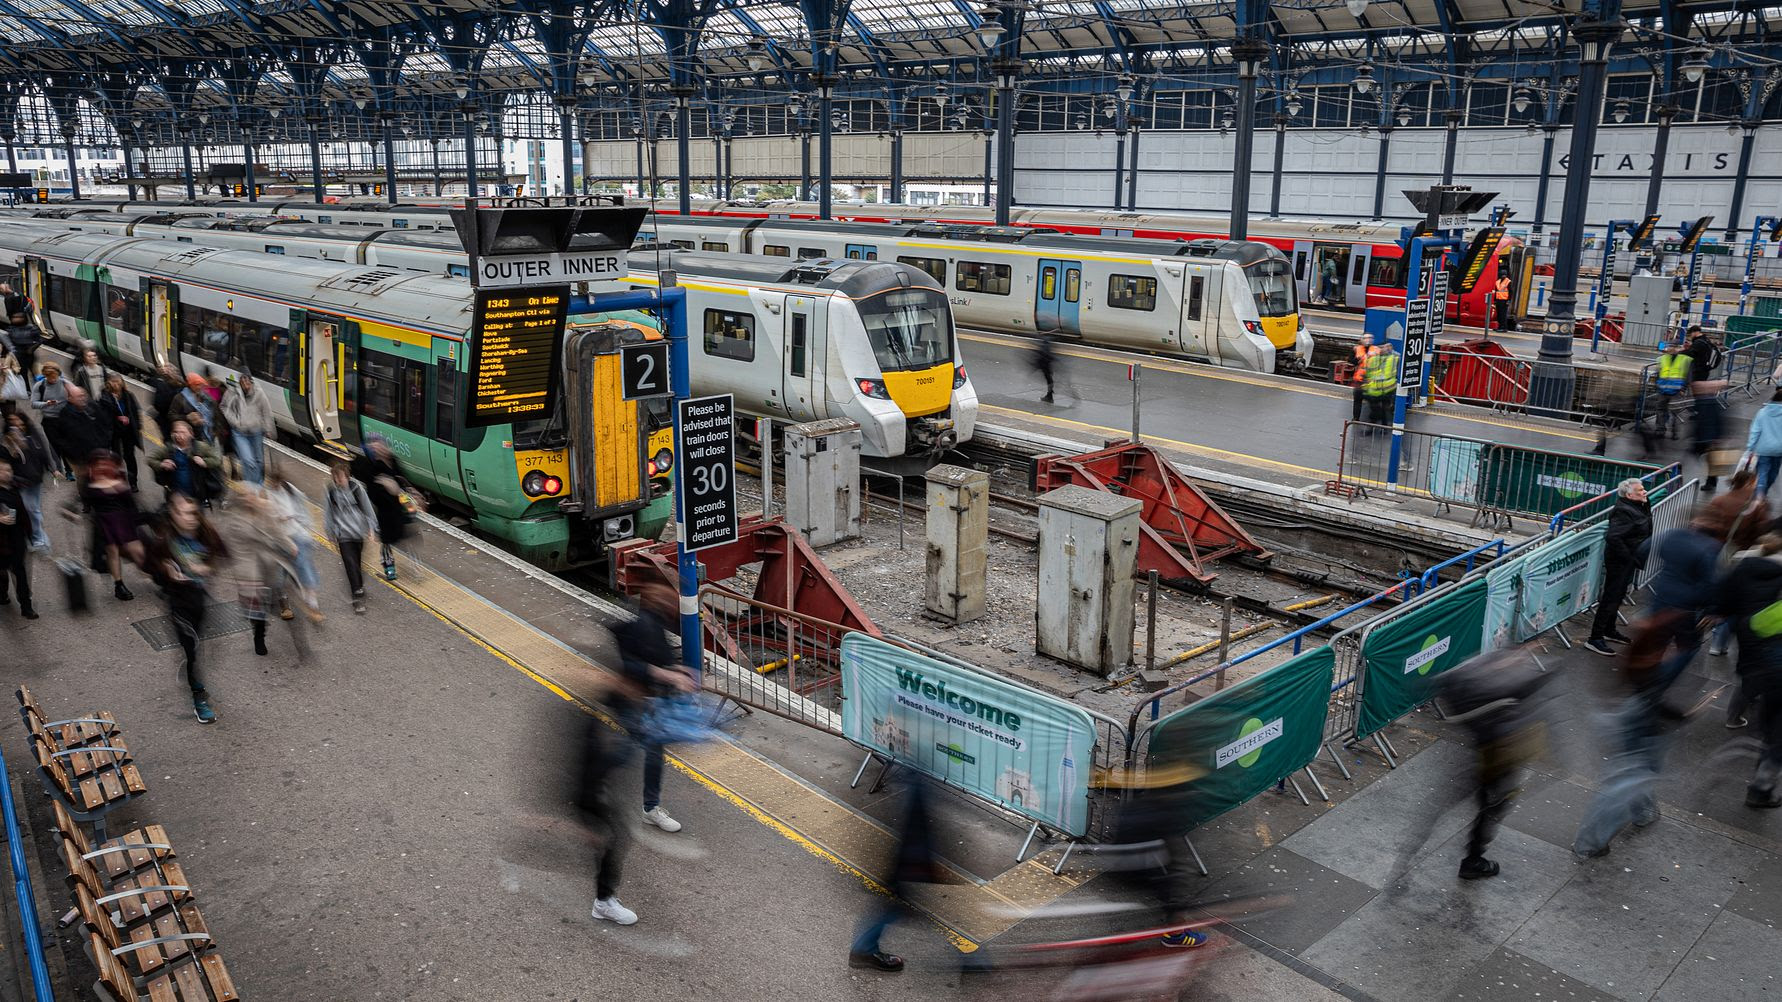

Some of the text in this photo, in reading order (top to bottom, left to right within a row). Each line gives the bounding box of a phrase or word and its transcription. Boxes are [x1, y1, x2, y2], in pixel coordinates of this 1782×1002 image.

[484, 256, 618, 279] OUTER INNER
[1419, 272, 1427, 292] 3
[488, 296, 559, 308] 1343 On time
[1434, 298, 1444, 312] 30
[1407, 338, 1422, 356] 30
[636, 354, 656, 390] 2
[916, 376, 935, 385] 700151
[476, 401, 519, 409] Southern
[688, 402, 725, 416] Please be
[683, 416, 731, 432] advised that
[386, 433, 411, 458] class
[658, 434, 670, 444] 143
[686, 430, 728, 445] train doors
[689, 445, 725, 459] will close
[525, 454, 563, 467] 377 143
[692, 462, 726, 495] 30
[694, 500, 726, 514] seconds
[696, 514, 725, 530] prior to
[692, 527, 730, 542] departure
[1546, 546, 1590, 575] Welcome
[1406, 640, 1448, 669] SOUTHERN
[895, 666, 1021, 732] Welcome
[898, 695, 1022, 750] Please have your ticket ready
[1219, 724, 1280, 762] SOUTHERN
